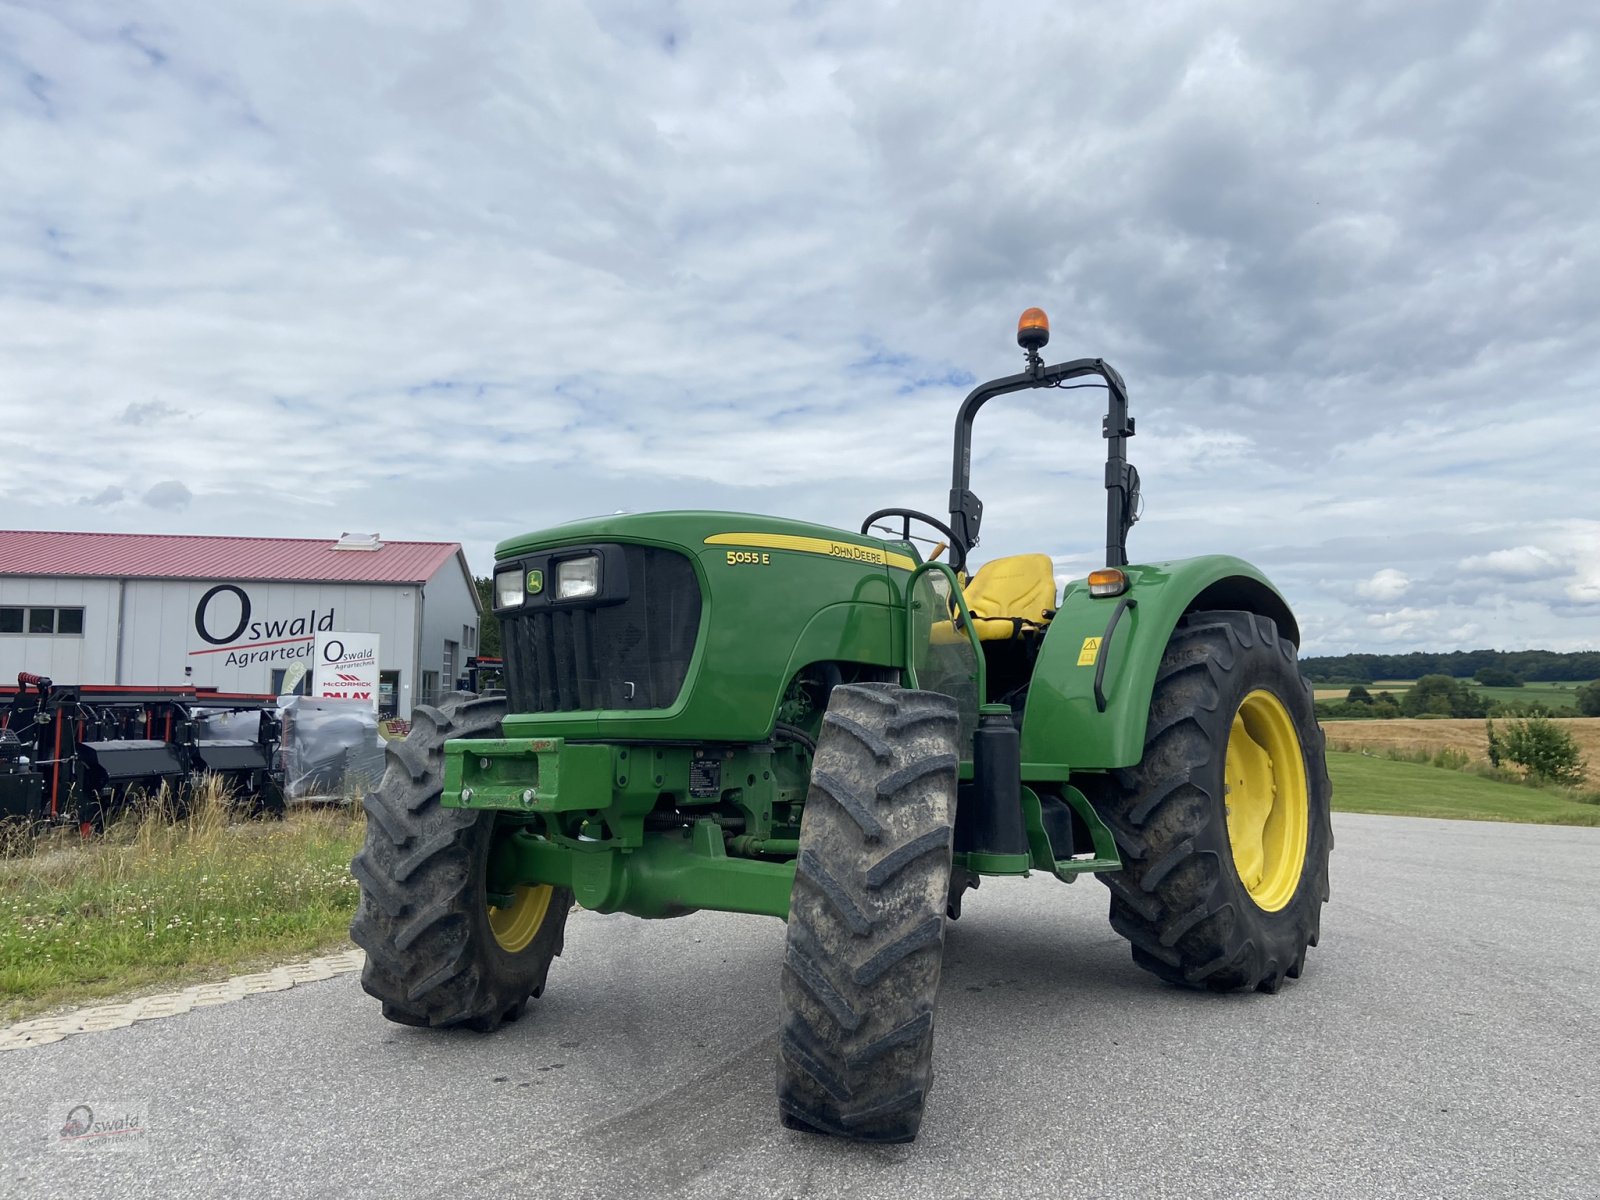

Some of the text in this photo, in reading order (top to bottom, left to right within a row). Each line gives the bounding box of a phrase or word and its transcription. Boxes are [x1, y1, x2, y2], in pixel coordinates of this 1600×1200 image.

[726, 551, 770, 565] 5055 E
[829, 543, 881, 563] JOHN DEERE
[195, 584, 335, 645] Oswald
[225, 641, 315, 668] Agrartech
[324, 640, 373, 662] Oswald
[335, 660, 375, 671] Agrartechnik
